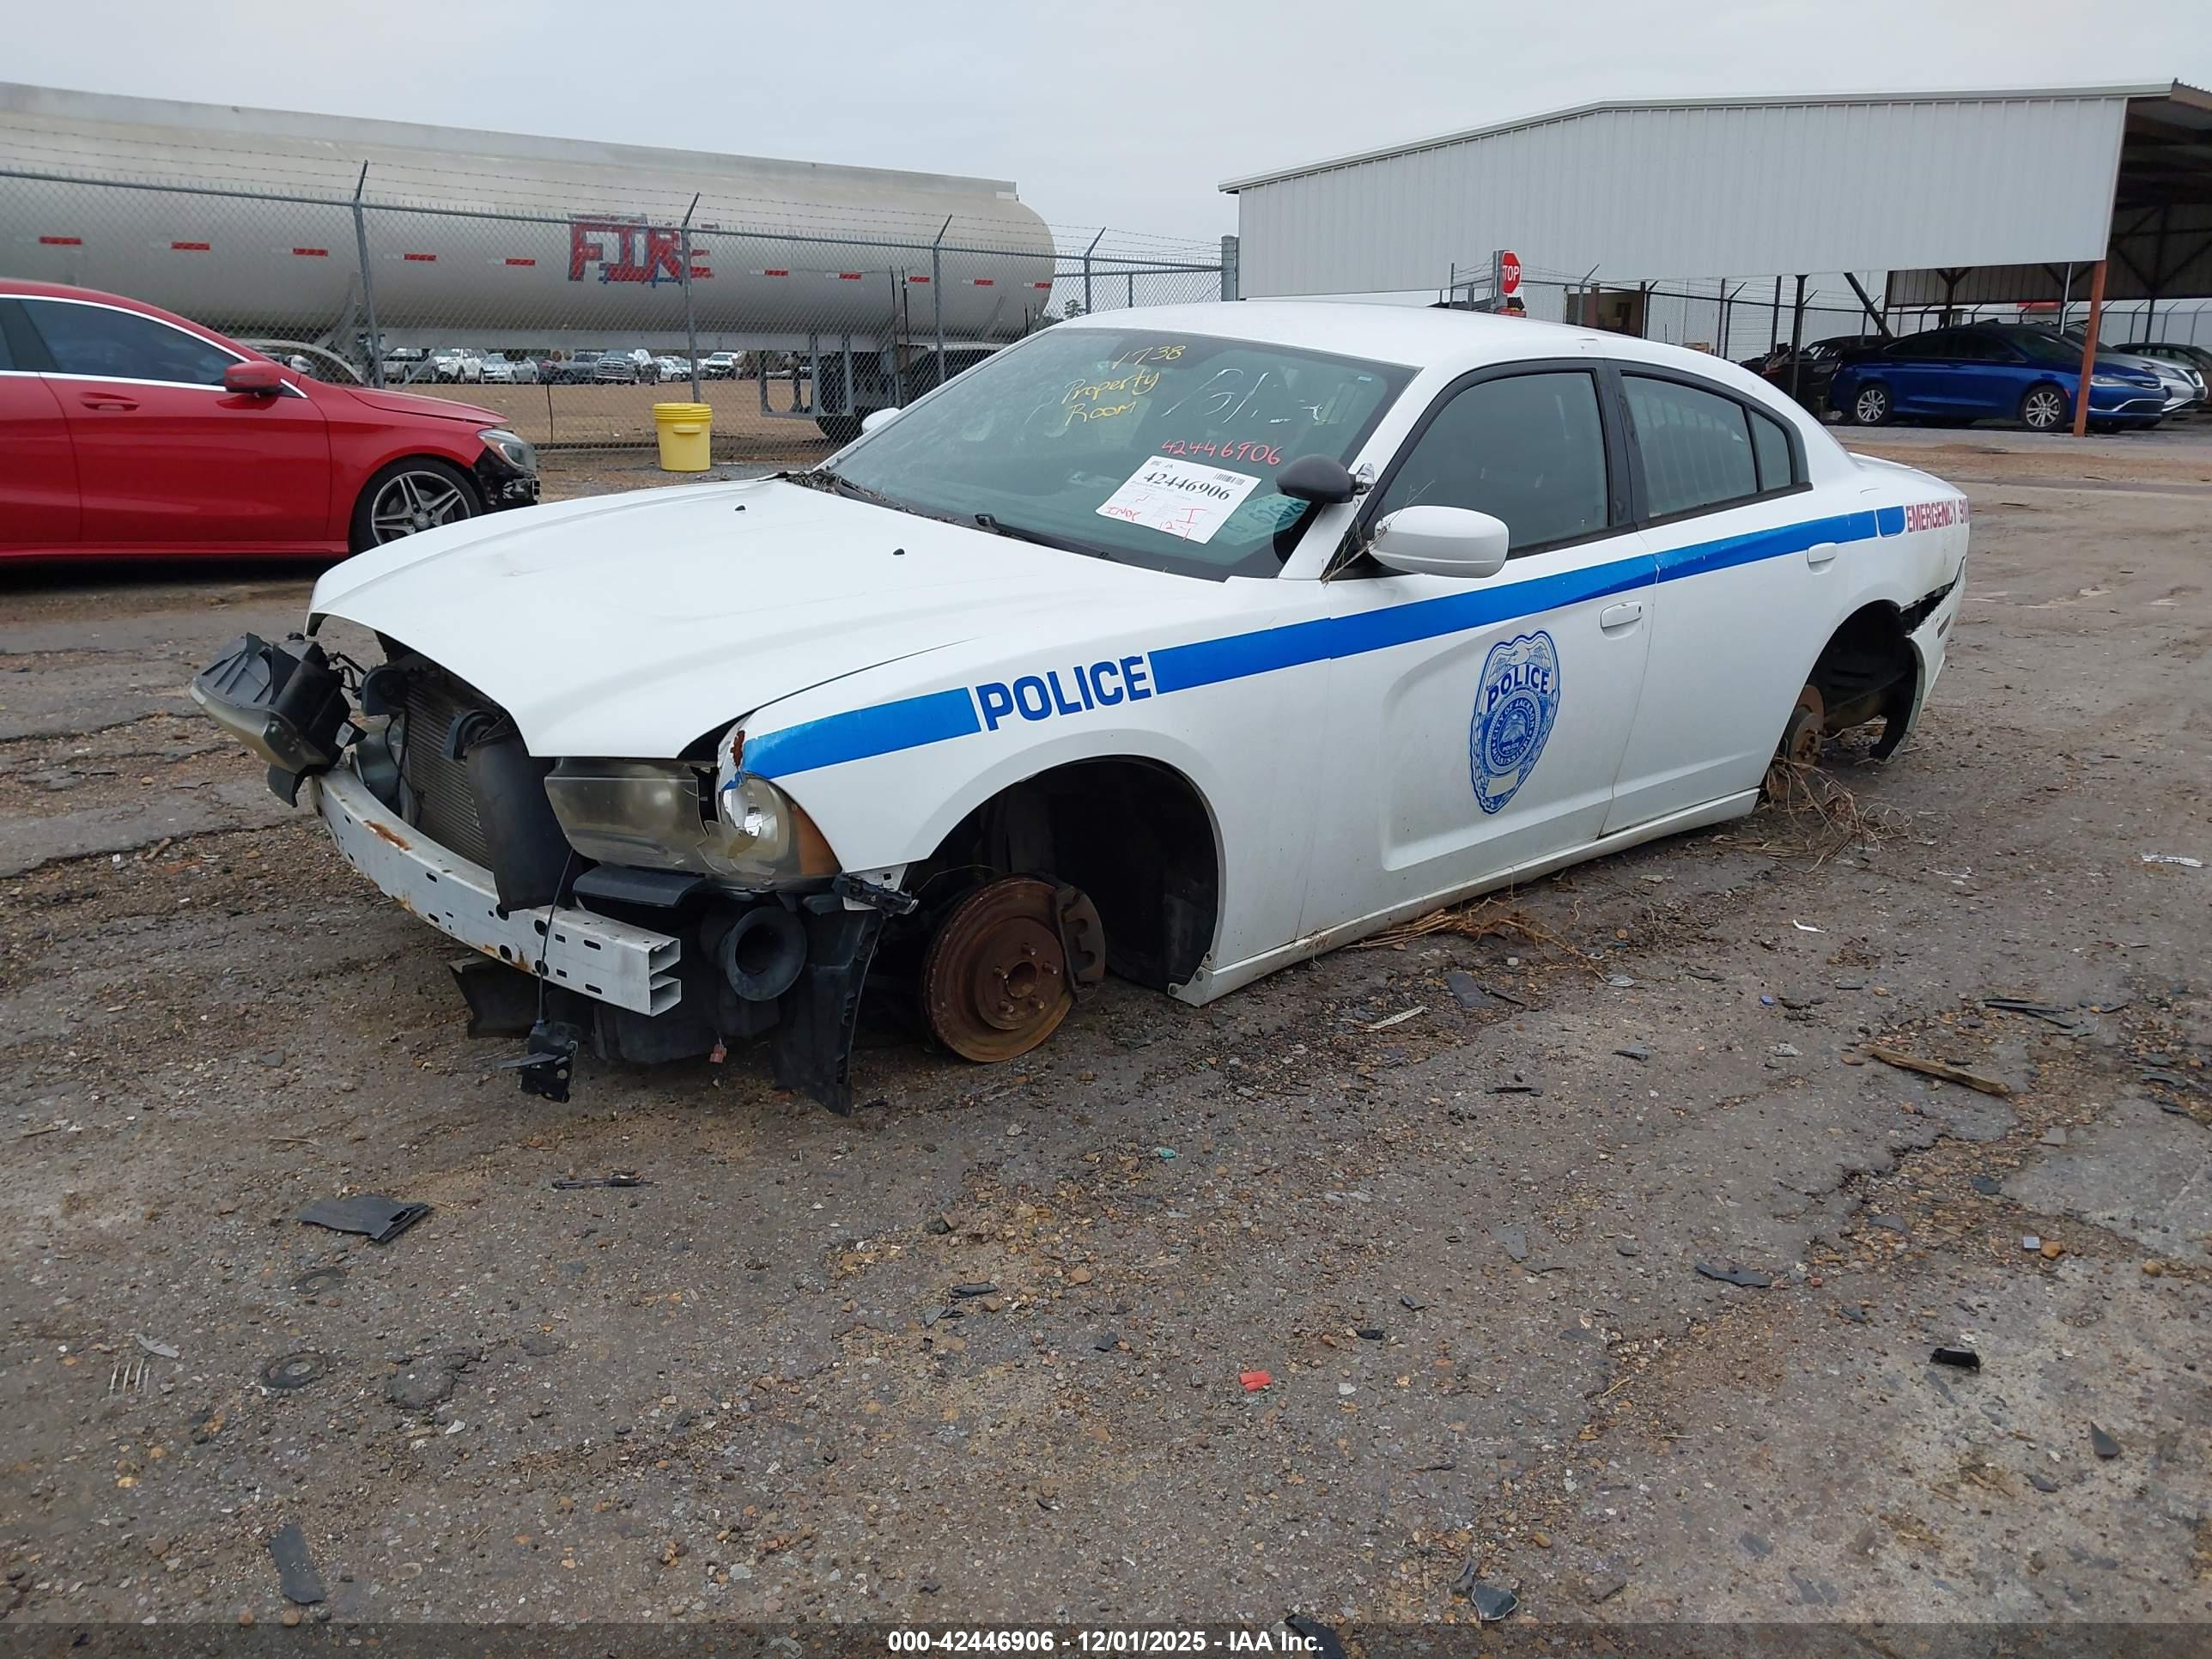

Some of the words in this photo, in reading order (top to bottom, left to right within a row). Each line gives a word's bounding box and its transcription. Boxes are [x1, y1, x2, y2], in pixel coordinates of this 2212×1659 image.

[1503, 265, 1520, 281] TOP
[1112, 345, 1187, 370] 1738
[1061, 368, 1159, 405] Property
[1161, 440, 1284, 465] 42446906
[1143, 471, 1236, 501] 42446906
[1906, 500, 1957, 532] EMERGENCY
[975, 655, 1152, 732] POLICE
[1487, 664, 1549, 713] POLICE
[1492, 714, 1504, 740] CITY
[1504, 703, 1514, 715] OF
[1515, 699, 1535, 728] JACKSON
